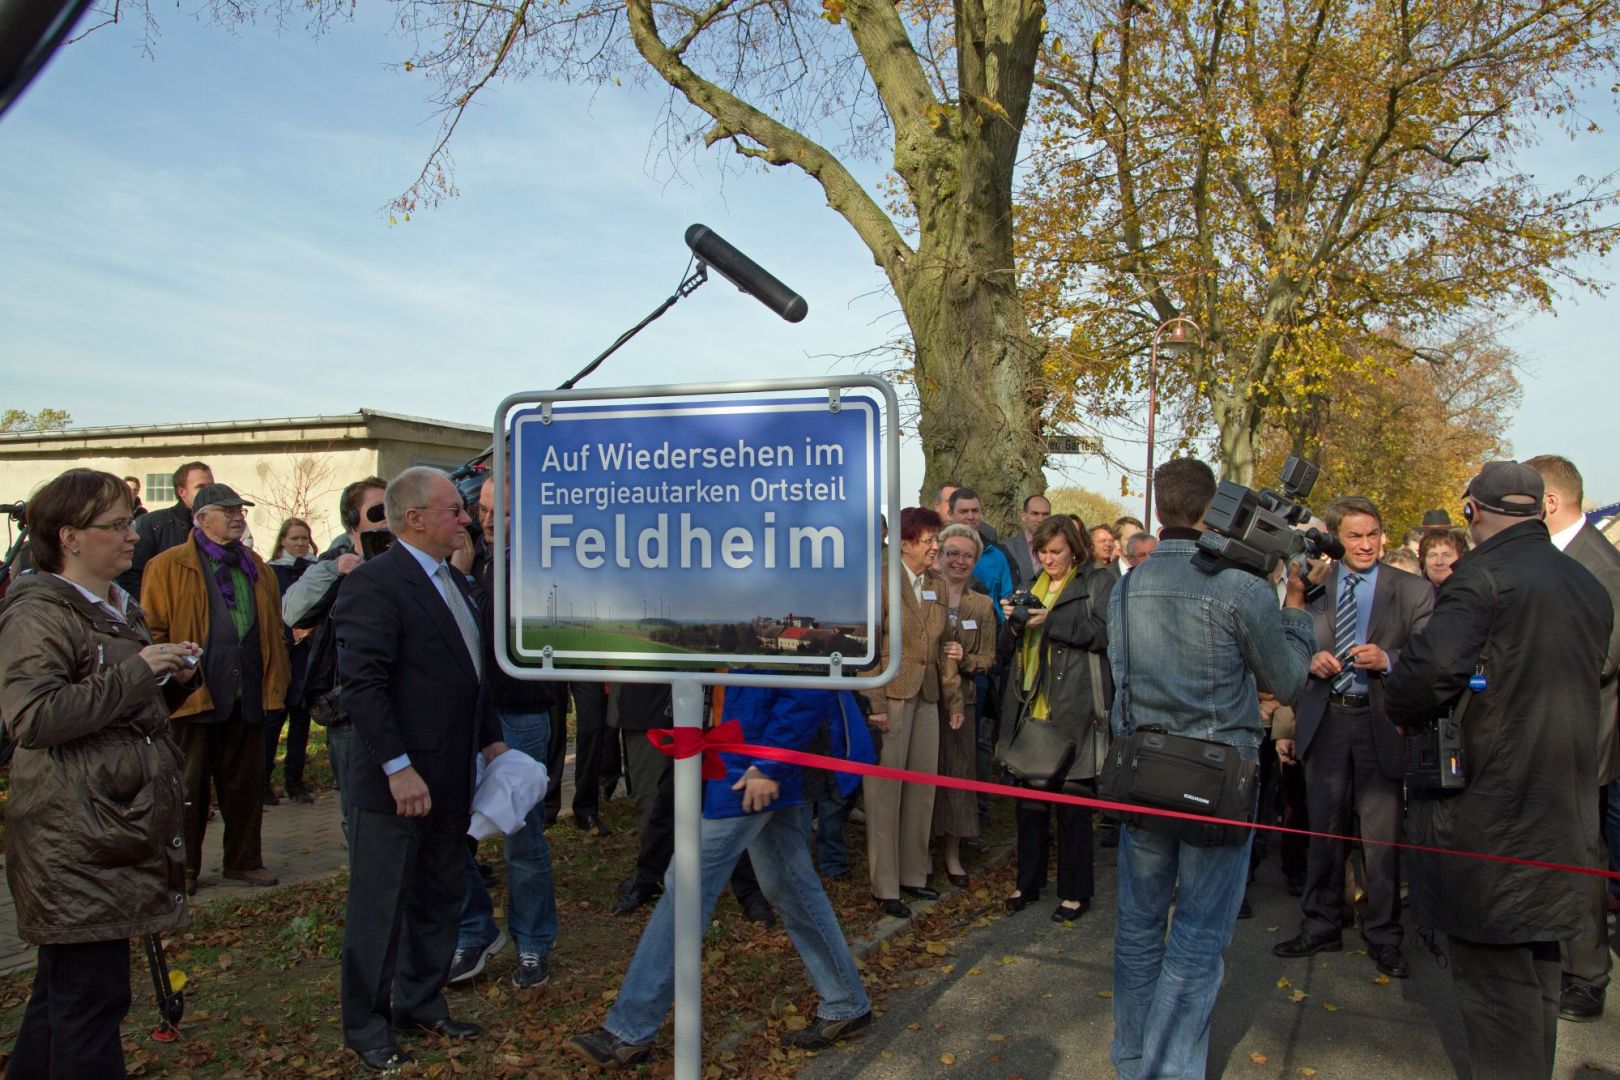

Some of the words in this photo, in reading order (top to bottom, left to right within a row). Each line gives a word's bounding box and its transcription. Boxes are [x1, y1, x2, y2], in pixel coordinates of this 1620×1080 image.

[541, 444, 590, 472] Auf
[598, 439, 794, 471] Wiedersehen
[806, 437, 843, 466] im
[541, 479, 740, 510] Energieautarken
[751, 476, 846, 503] Ortsteil
[541, 511, 845, 569] Feldheim
